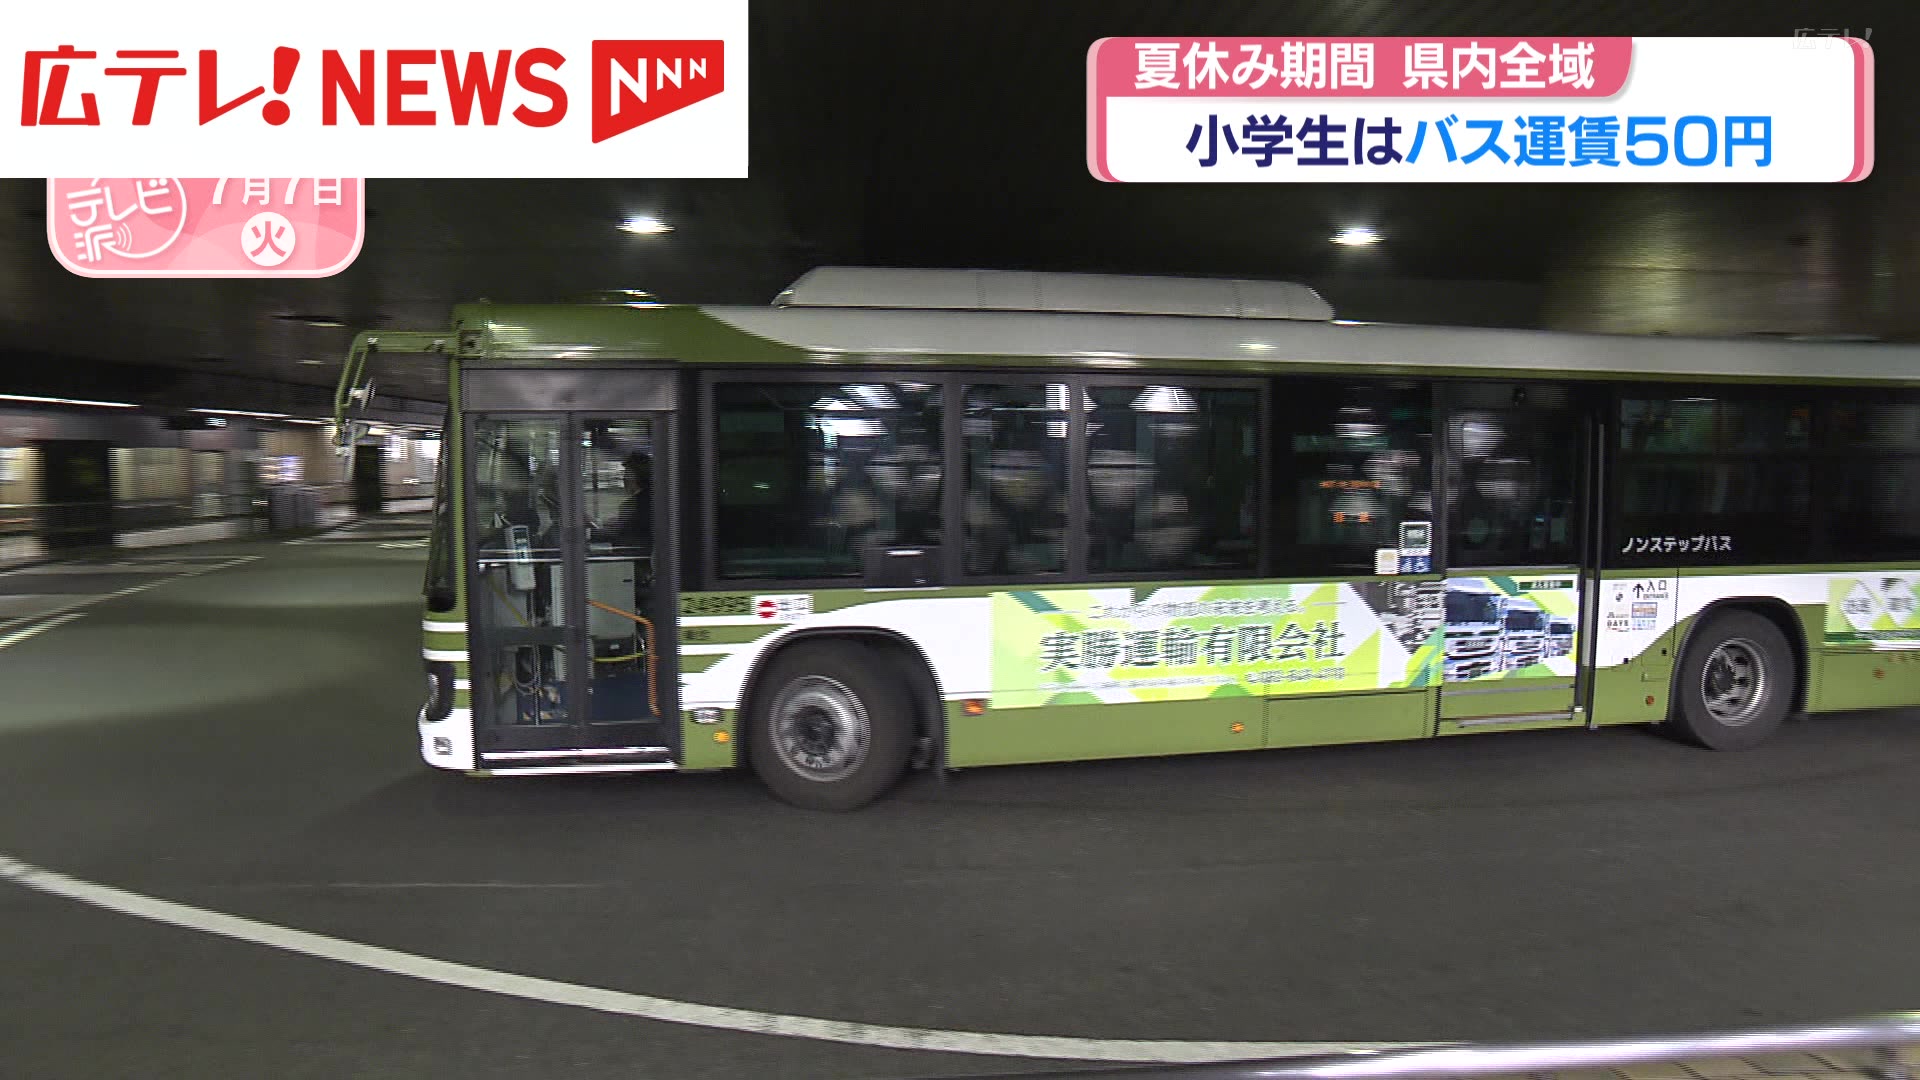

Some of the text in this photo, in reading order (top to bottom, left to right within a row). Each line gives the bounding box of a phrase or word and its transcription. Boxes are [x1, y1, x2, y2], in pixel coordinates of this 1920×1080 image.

[1621, 535, 1732, 553] ノンステップバス
[1646, 580, 1667, 592] 入口
[680, 596, 750, 615] 24995
[1039, 621, 1346, 674] 実勝運輸有限会社
